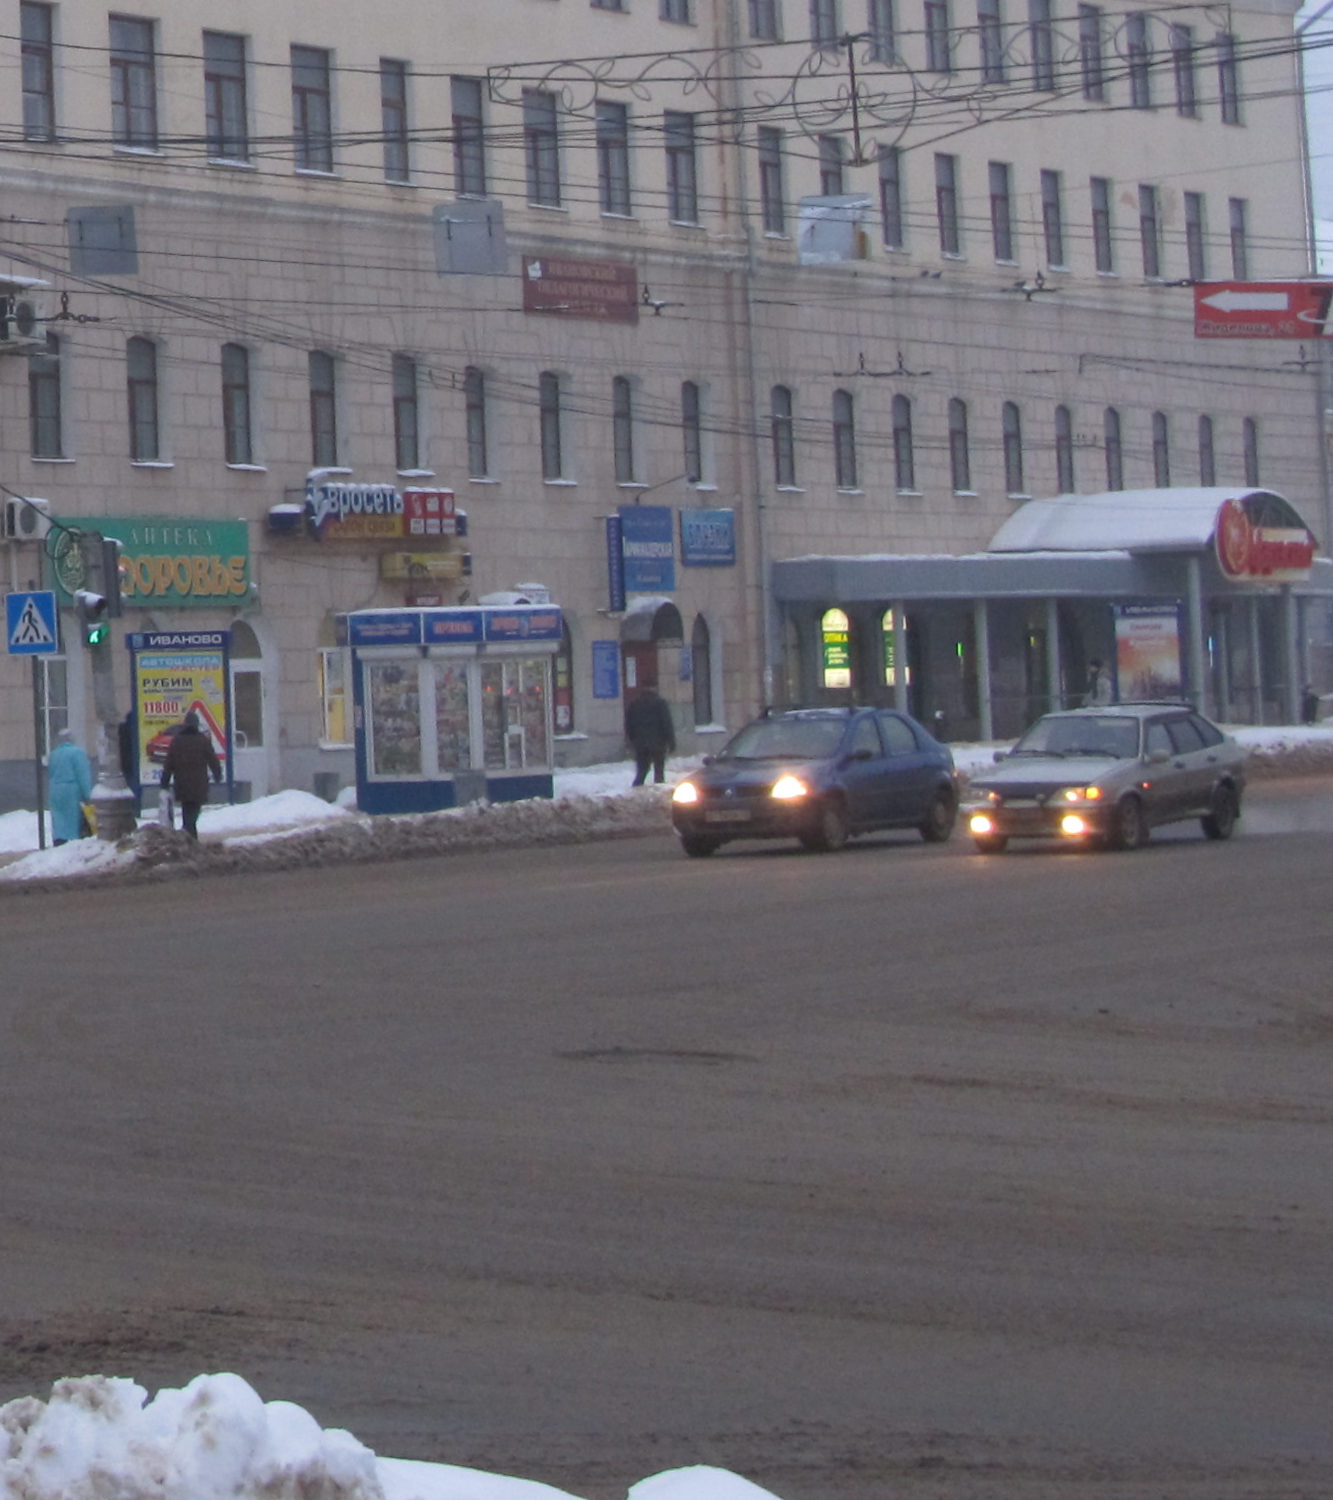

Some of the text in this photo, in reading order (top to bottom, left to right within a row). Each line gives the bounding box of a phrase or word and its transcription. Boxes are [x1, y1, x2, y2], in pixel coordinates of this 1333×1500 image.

[132, 527, 213, 546] АПТЕКА
[118, 555, 247, 595] ДОРОВЬЕ
[149, 634, 222, 645] ИВАНОВО
[141, 656, 220, 667] АВТОШКОЛА
[142, 677, 193, 687] РУБИМ
[143, 701, 179, 714] 11800
